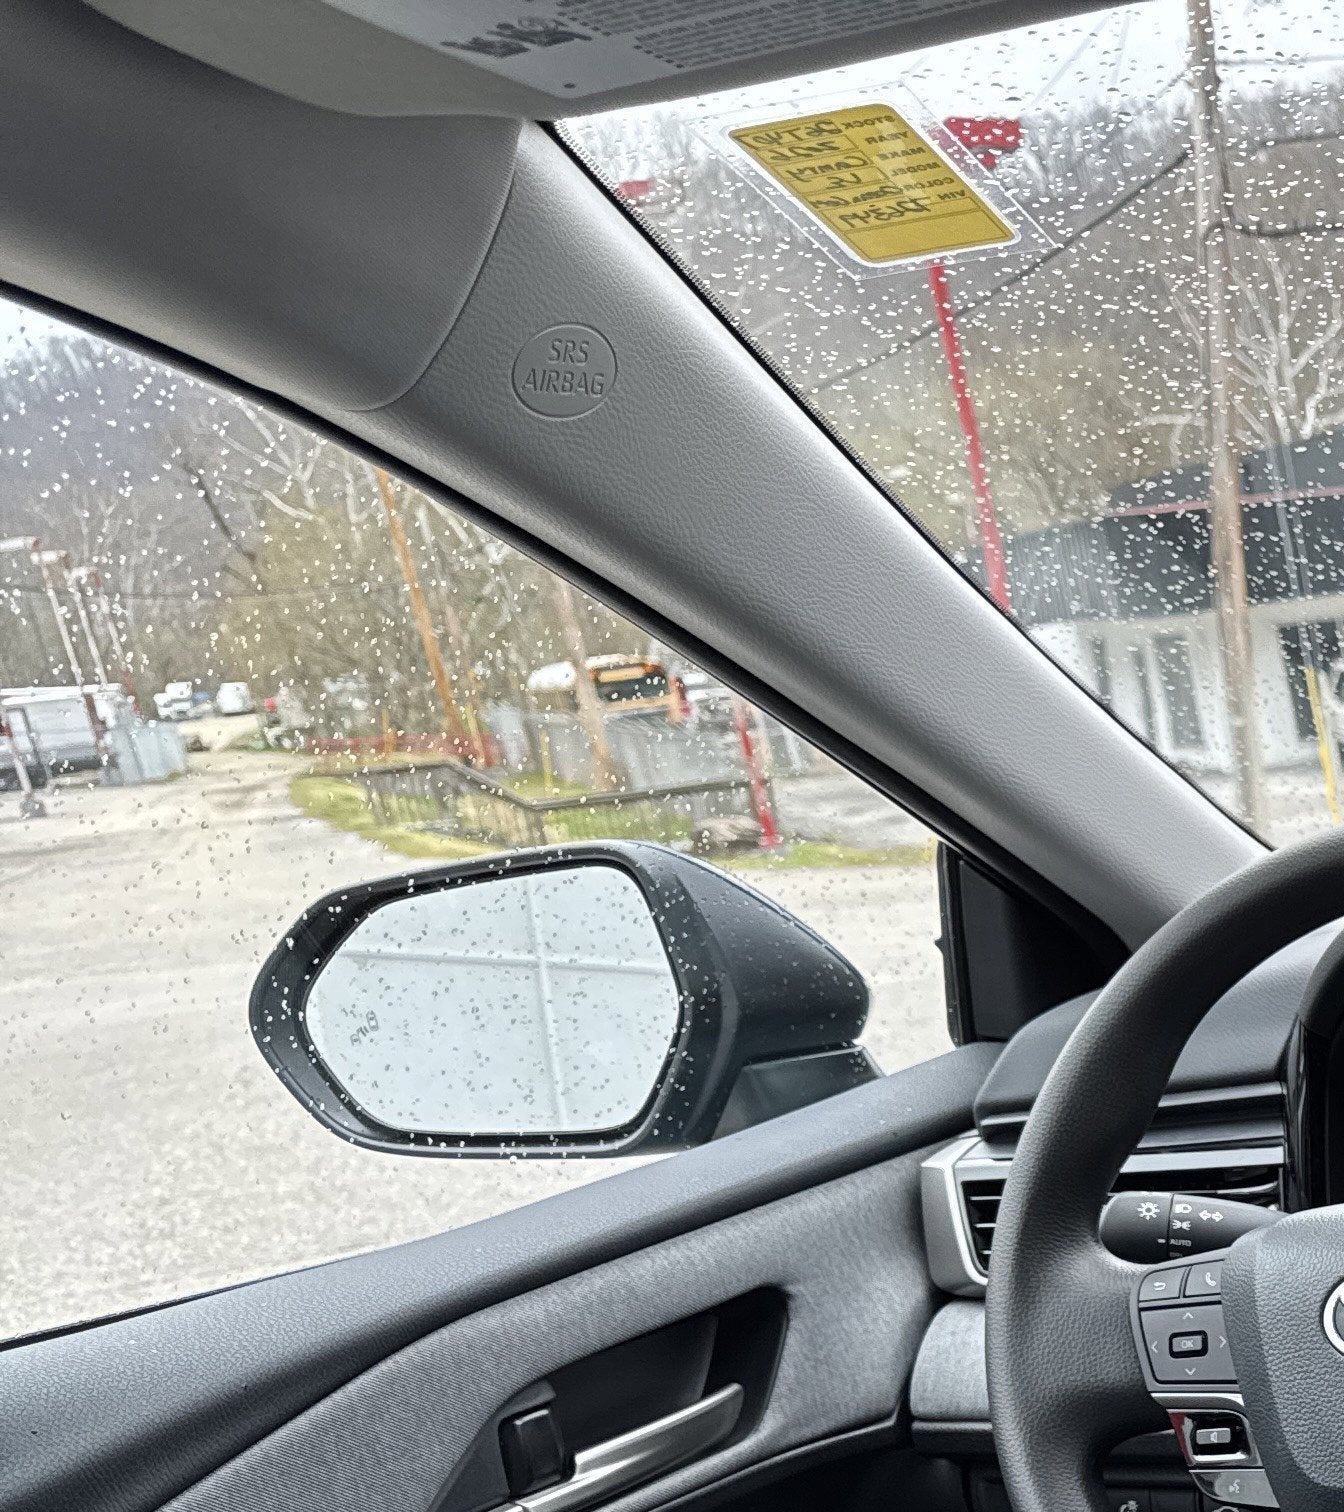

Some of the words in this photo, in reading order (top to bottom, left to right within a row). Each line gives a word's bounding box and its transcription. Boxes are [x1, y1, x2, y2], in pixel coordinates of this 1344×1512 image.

[548, 338, 589, 364] SRS
[521, 368, 605, 397] AIRBAG
[1169, 1239, 1192, 1247] AUTO
[1181, 1340, 1194, 1349] OK
